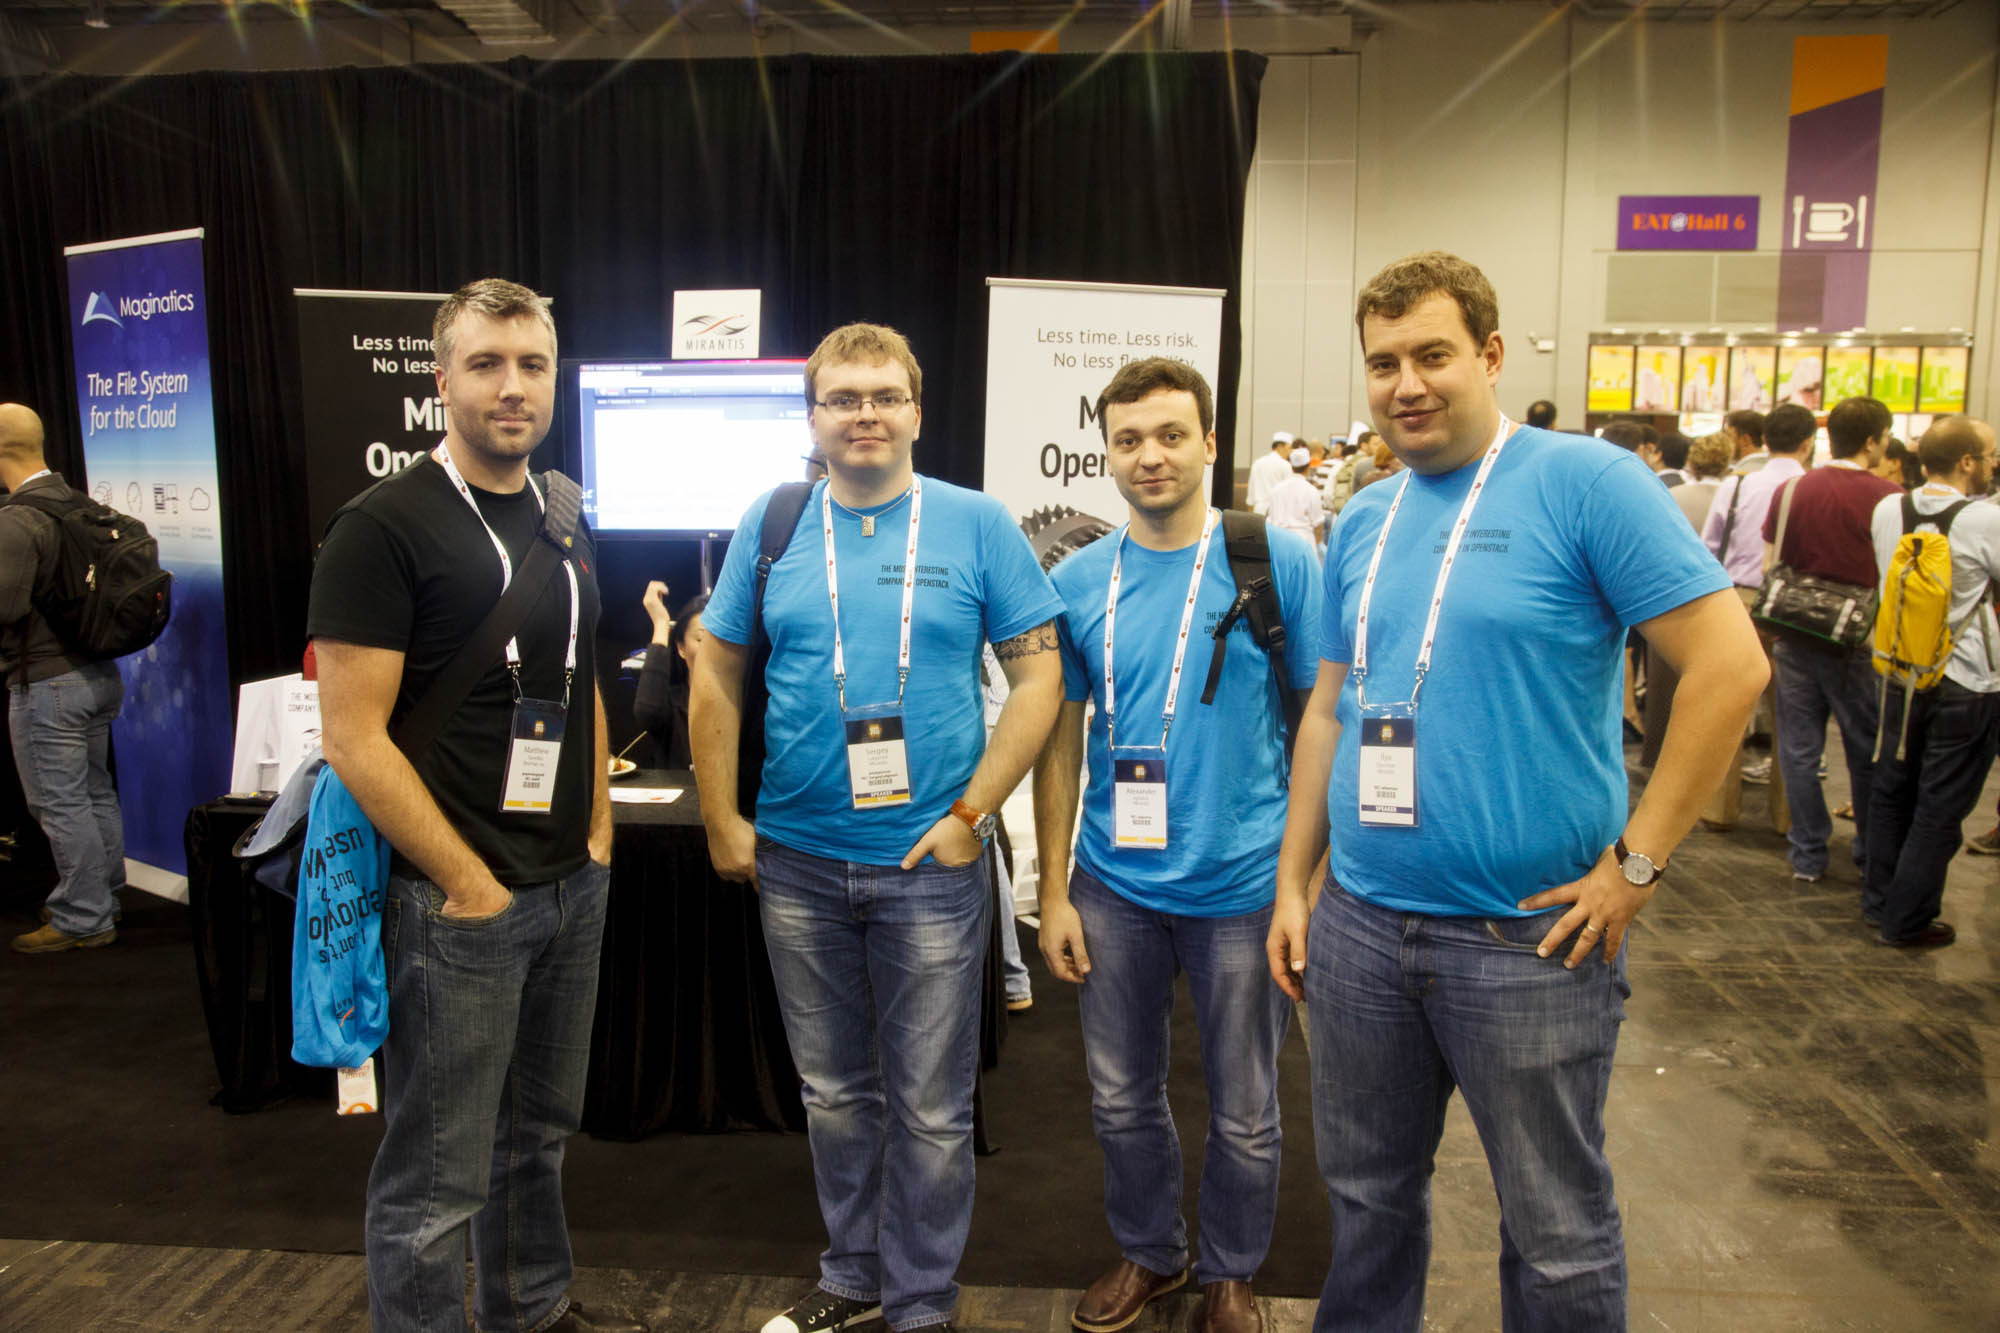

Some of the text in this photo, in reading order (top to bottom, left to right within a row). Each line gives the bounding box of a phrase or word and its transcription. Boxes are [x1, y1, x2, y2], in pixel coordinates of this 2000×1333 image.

[120, 289, 194, 320] Maginatics
[353, 335, 393, 351] Less
[686, 338, 745, 352] MIRANTIS
[1038, 328, 1198, 348] Less time. Less risk.
[372, 357, 399, 373] No
[1054, 352, 1076, 368] No
[1083, 353, 1114, 369] less
[87, 370, 188, 401] The File System
[89, 402, 177, 436] for the Cloud
[881, 564, 892, 573] THE
[1206, 612, 1217, 620] THE
[330, 869, 357, 891] but
